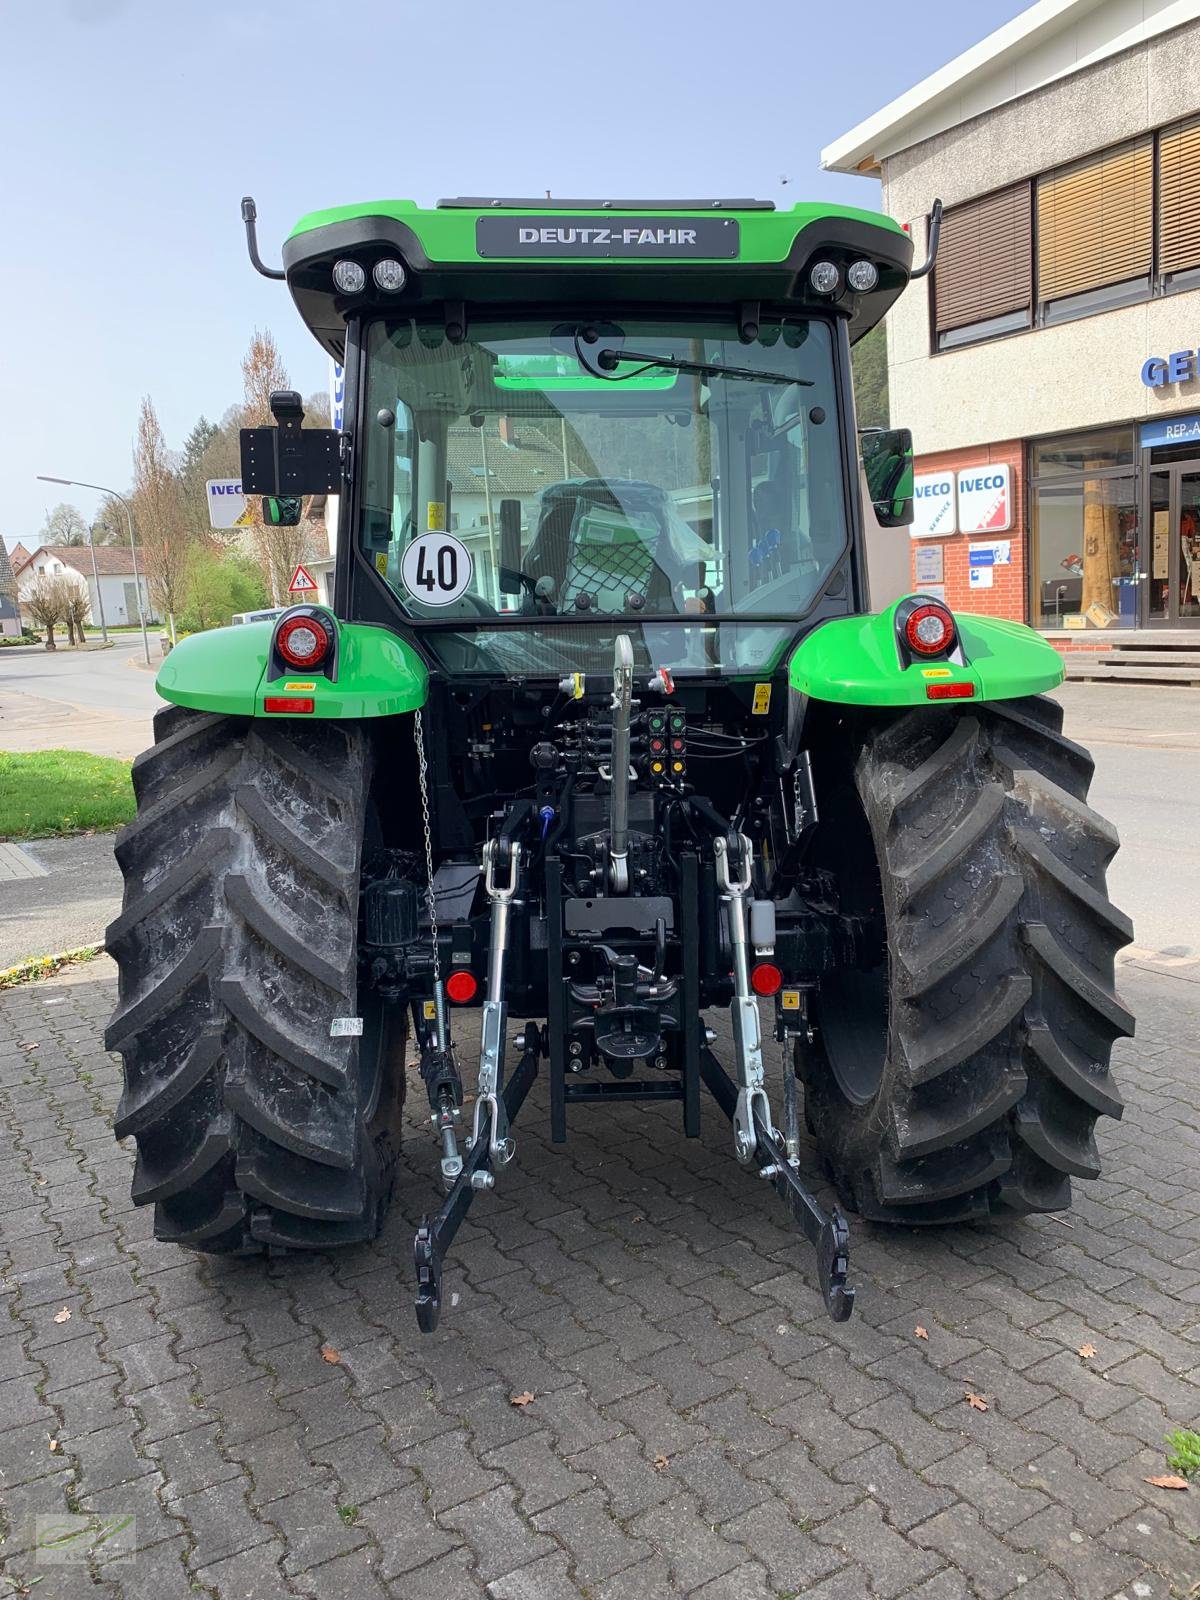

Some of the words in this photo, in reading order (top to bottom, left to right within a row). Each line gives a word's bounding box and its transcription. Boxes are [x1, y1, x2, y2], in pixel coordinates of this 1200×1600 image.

[518, 227, 697, 245] DEUTZ-FAHR
[1141, 349, 1200, 388] GE
[960, 475, 1004, 493] IVECO
[415, 544, 458, 592] 40
